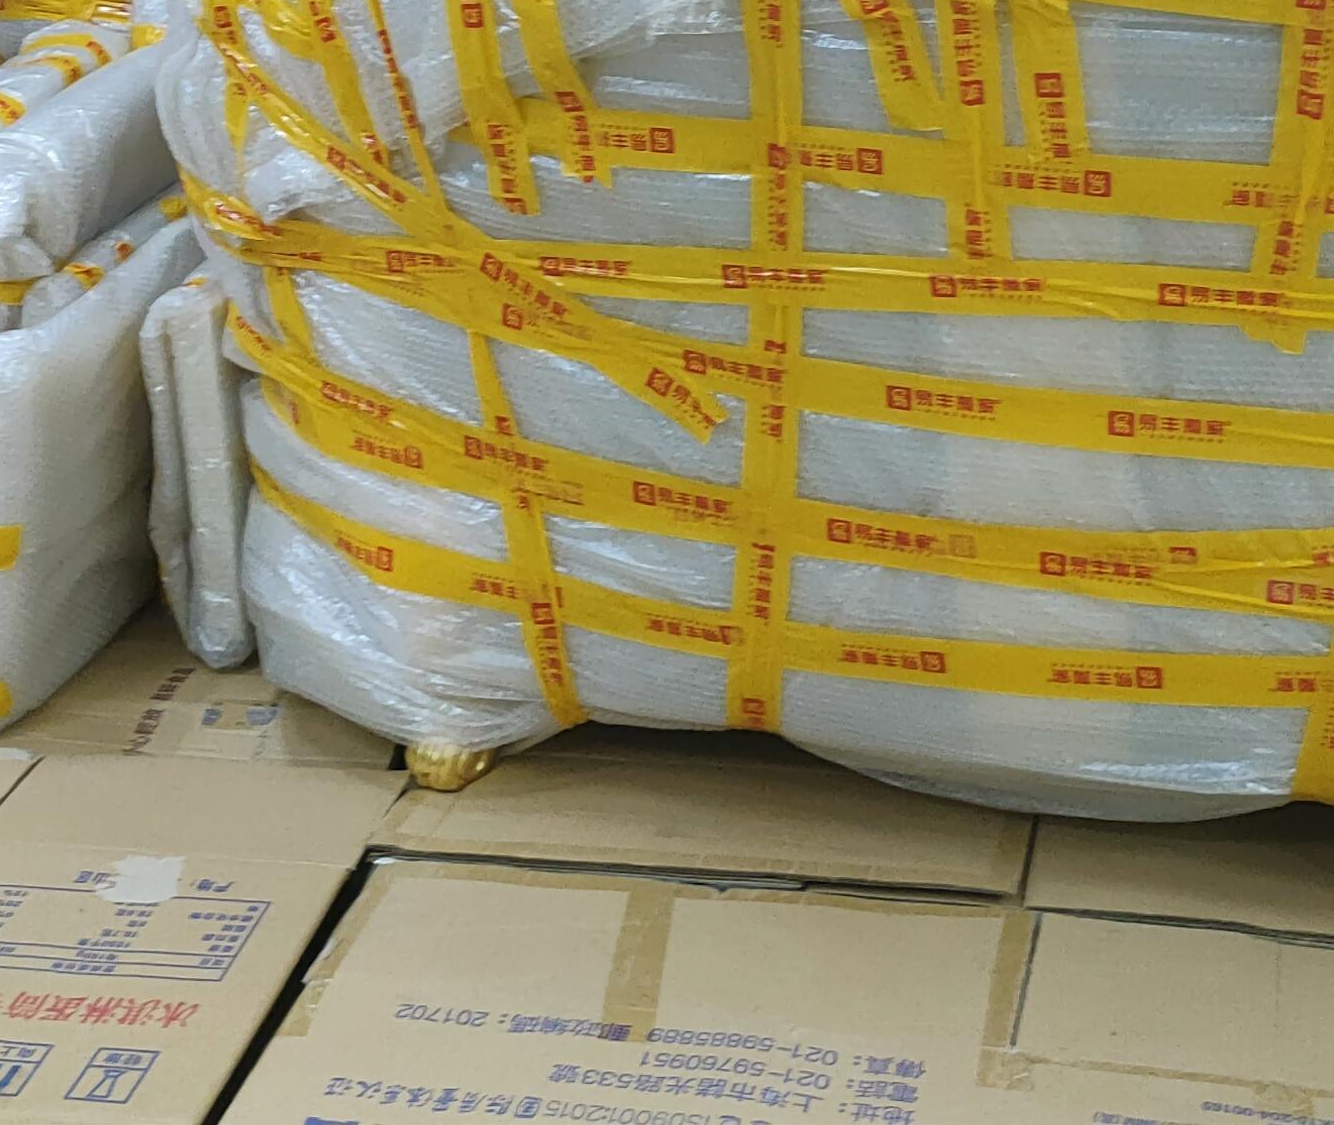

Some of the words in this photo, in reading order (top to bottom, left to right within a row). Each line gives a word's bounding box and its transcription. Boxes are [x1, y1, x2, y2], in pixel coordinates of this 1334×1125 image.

[915, 389, 1001, 413] 易丰搬家
[1139, 413, 1230, 436] 易丰搬家
